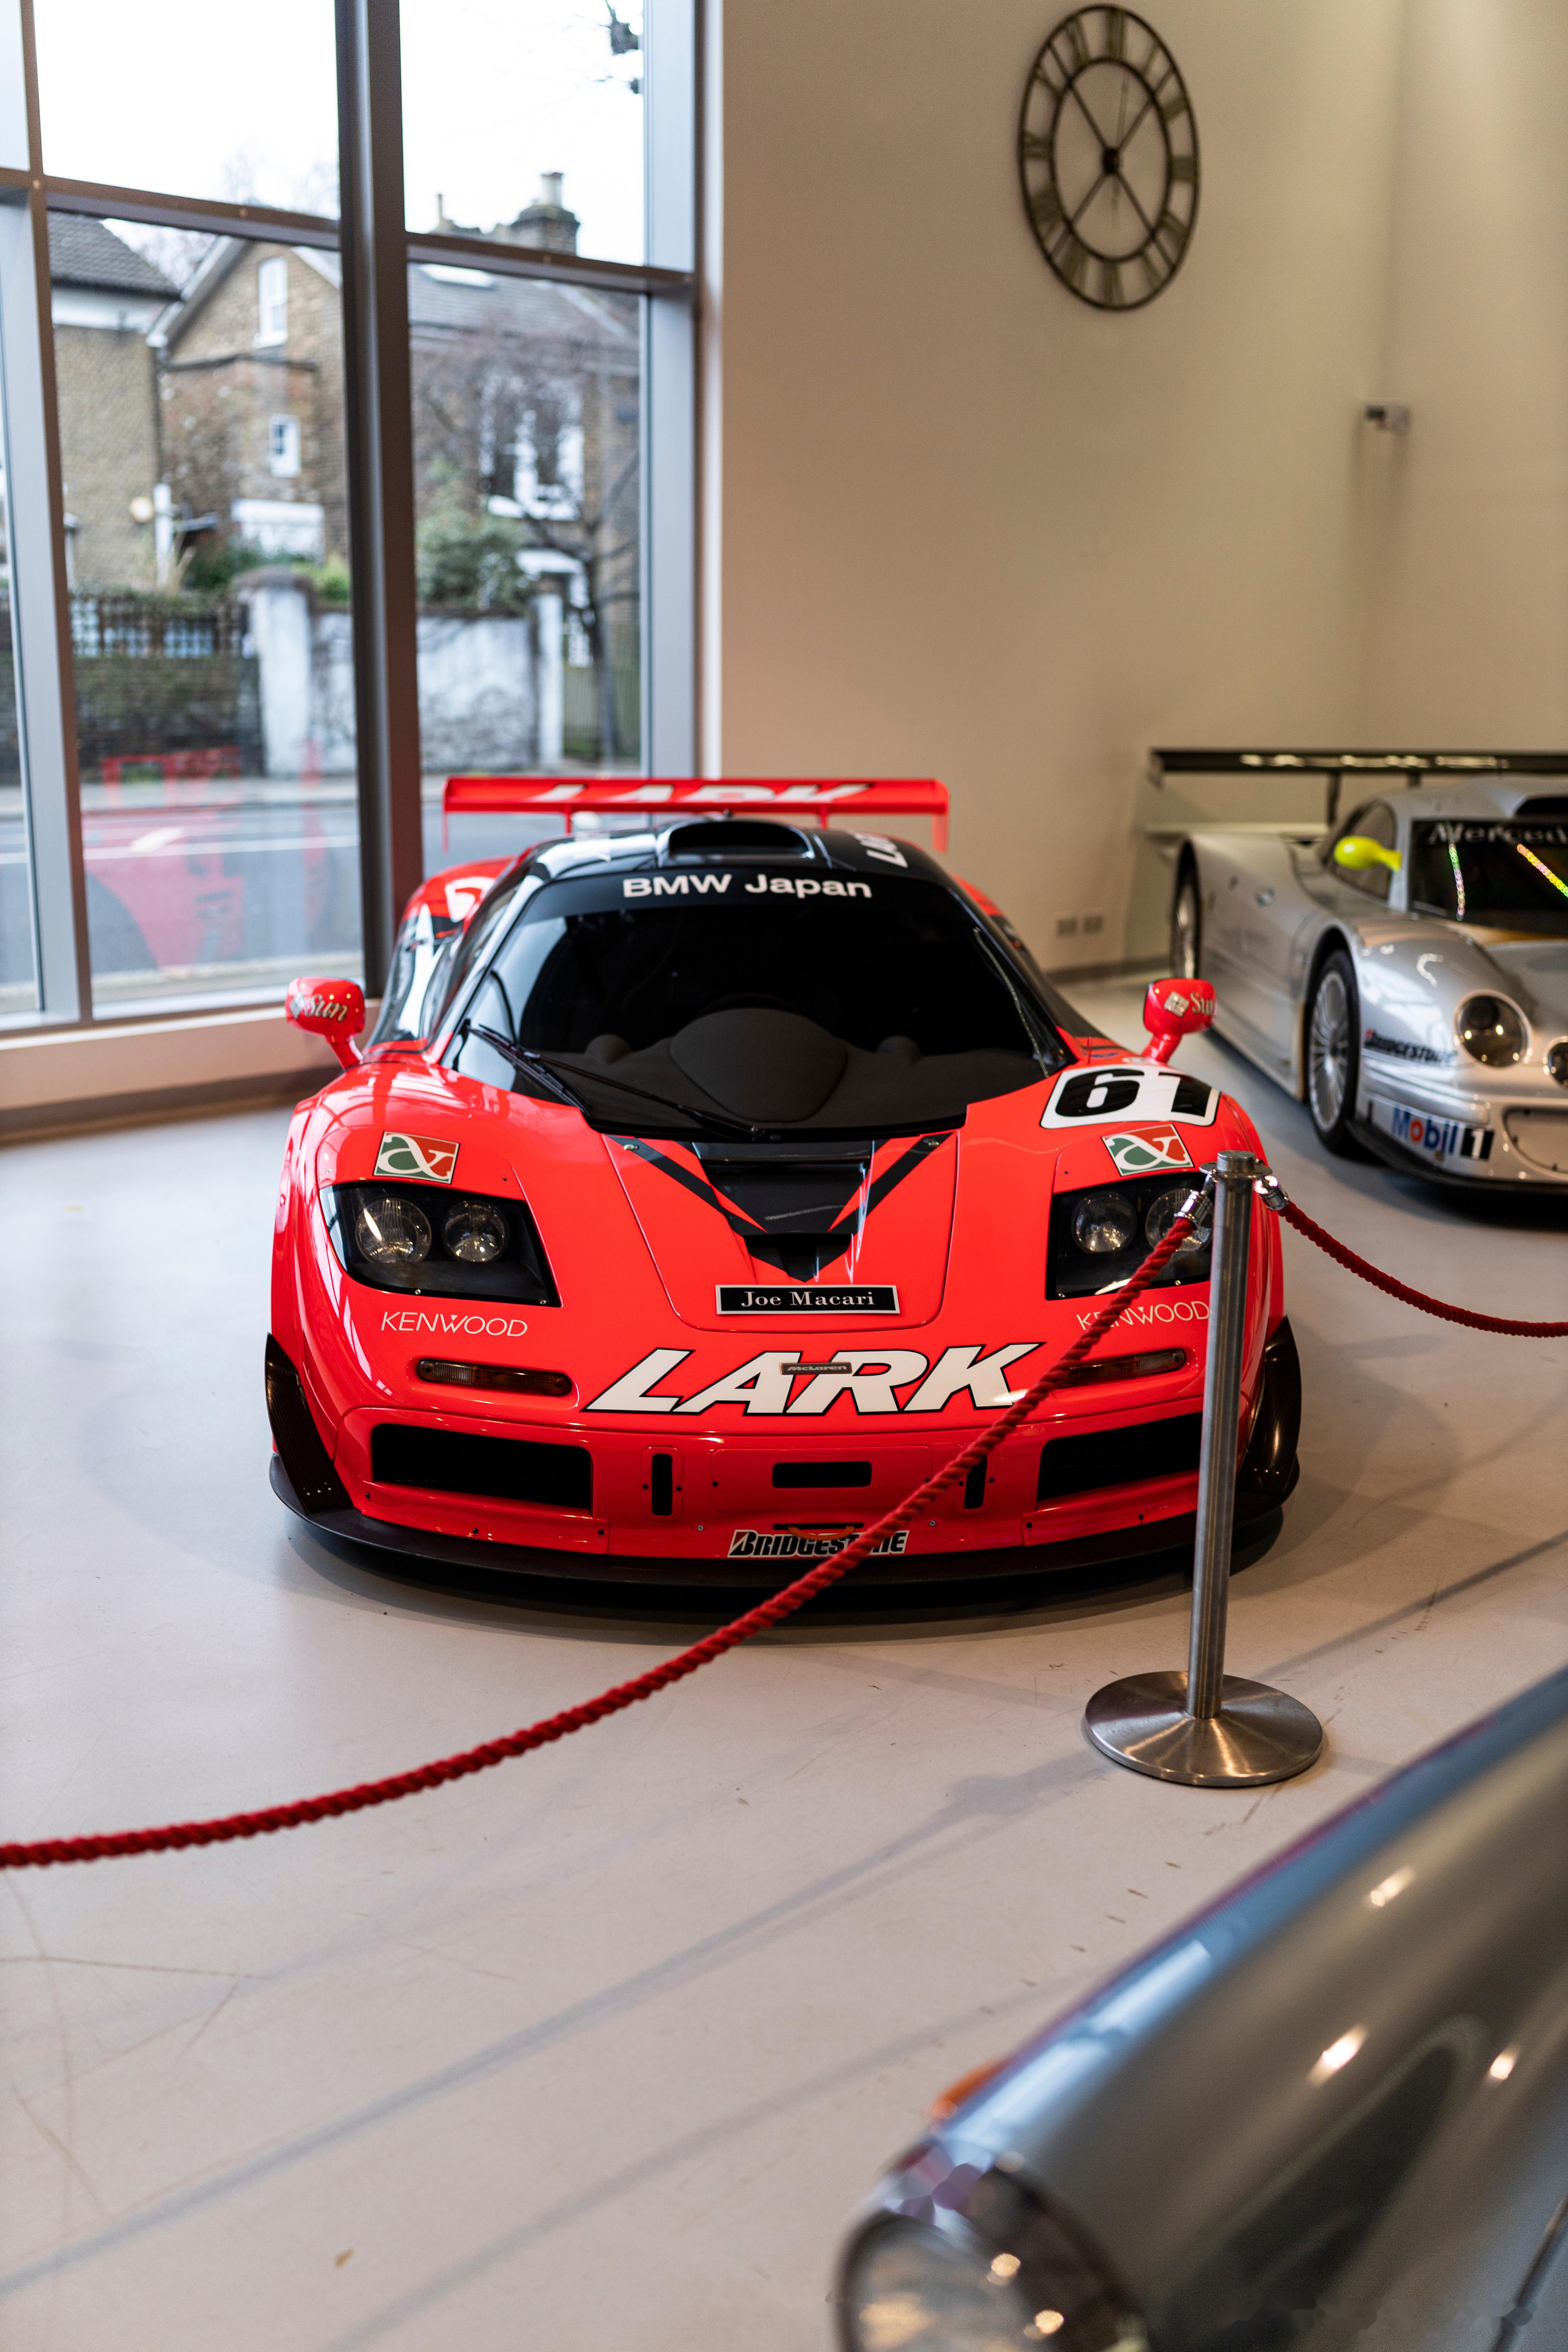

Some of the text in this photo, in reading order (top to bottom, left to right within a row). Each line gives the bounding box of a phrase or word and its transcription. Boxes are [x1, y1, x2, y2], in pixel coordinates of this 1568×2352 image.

[623, 874, 872, 899] BMW Japan
[304, 993, 348, 1022] Sun
[1055, 1068, 1212, 1117] 61
[1392, 1104, 1458, 1156] Mobil
[741, 1291, 875, 1307] Joe Macari
[381, 1311, 528, 1337] KENWOOD
[580, 1342, 1047, 1416] LARK
